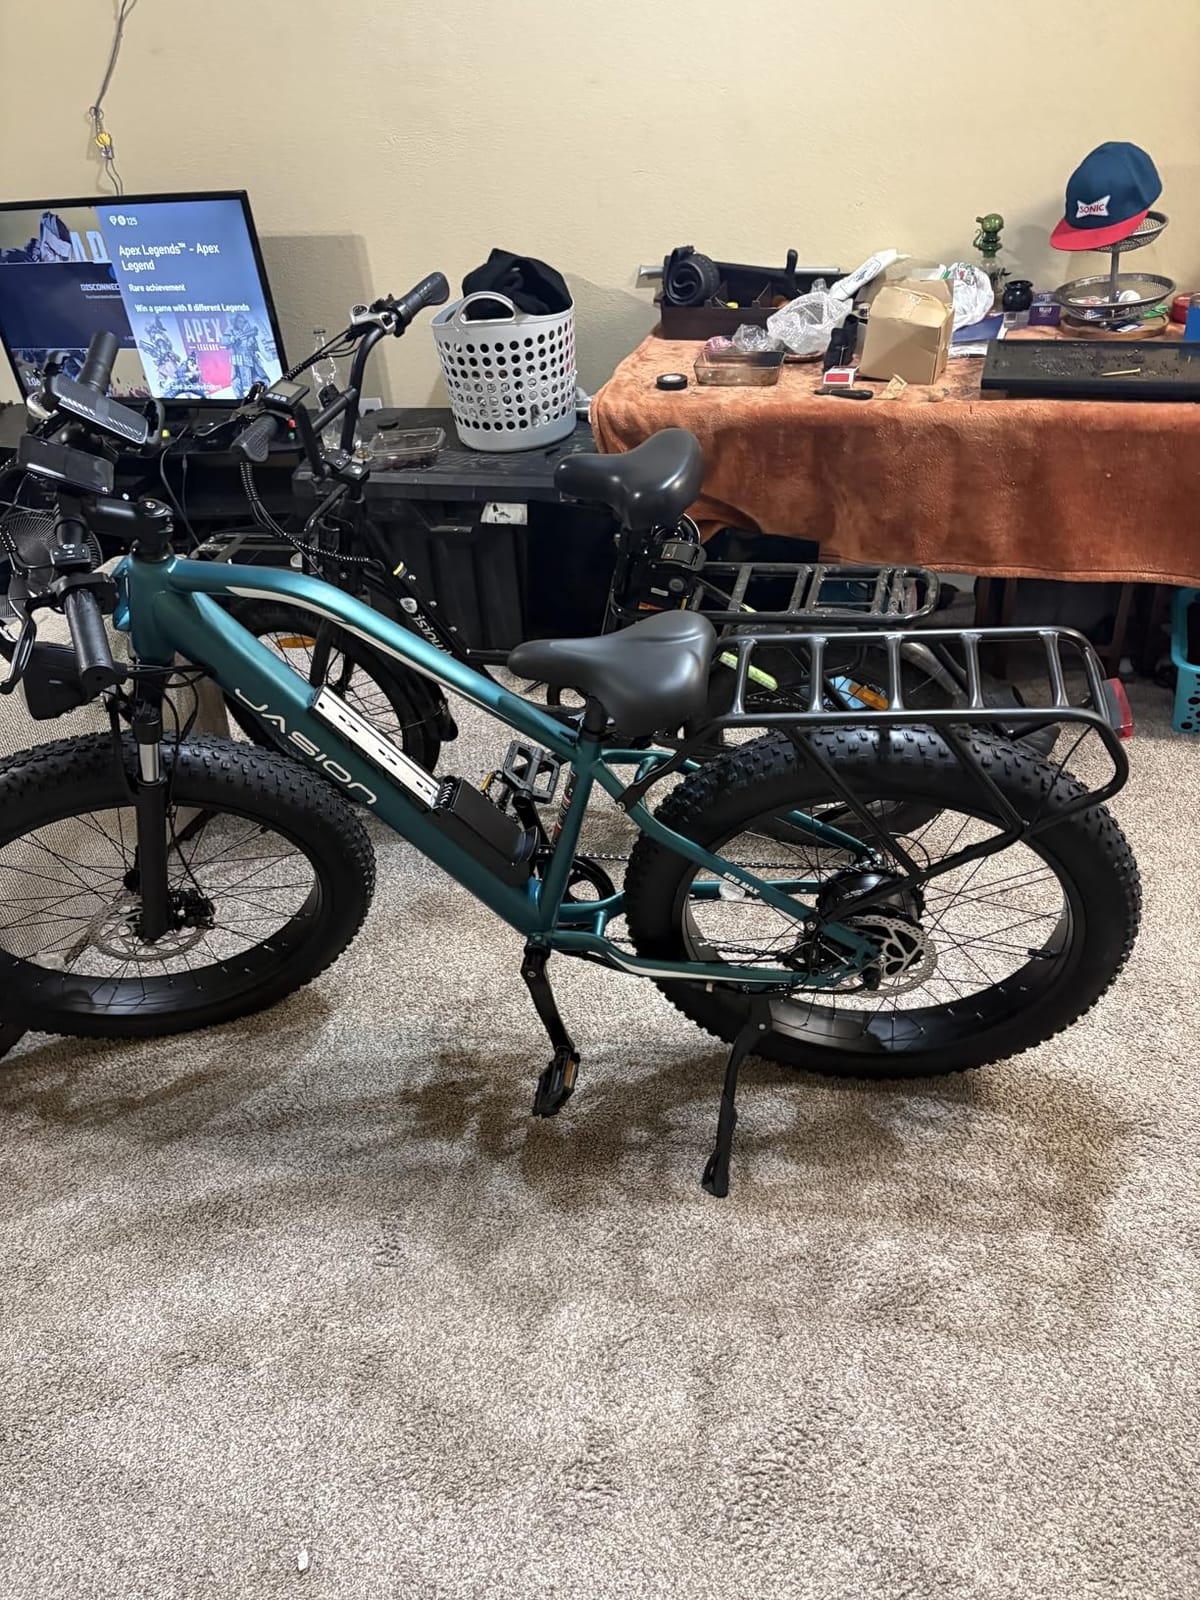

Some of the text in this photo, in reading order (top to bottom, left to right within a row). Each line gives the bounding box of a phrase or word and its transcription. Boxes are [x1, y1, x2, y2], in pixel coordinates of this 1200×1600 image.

[1080, 203, 1105, 214] SONIC
[127, 216, 138, 226] 125
[119, 244, 142, 258] Apex
[196, 242, 220, 257] Apex
[121, 259, 155, 273] Legend
[80, 282, 120, 292] DISCONNEC
[128, 283, 186, 293] Rare achievement
[134, 304, 149, 313] Win
[154, 305, 172, 315] game
[172, 303, 187, 313] with
[193, 303, 221, 313] different
[220, 303, 250, 314] Legends
[183, 318, 223, 343] APEX
[412, 614, 453, 655] isinw
[234, 688, 378, 805] JASION
[740, 881, 760, 896] MAX
